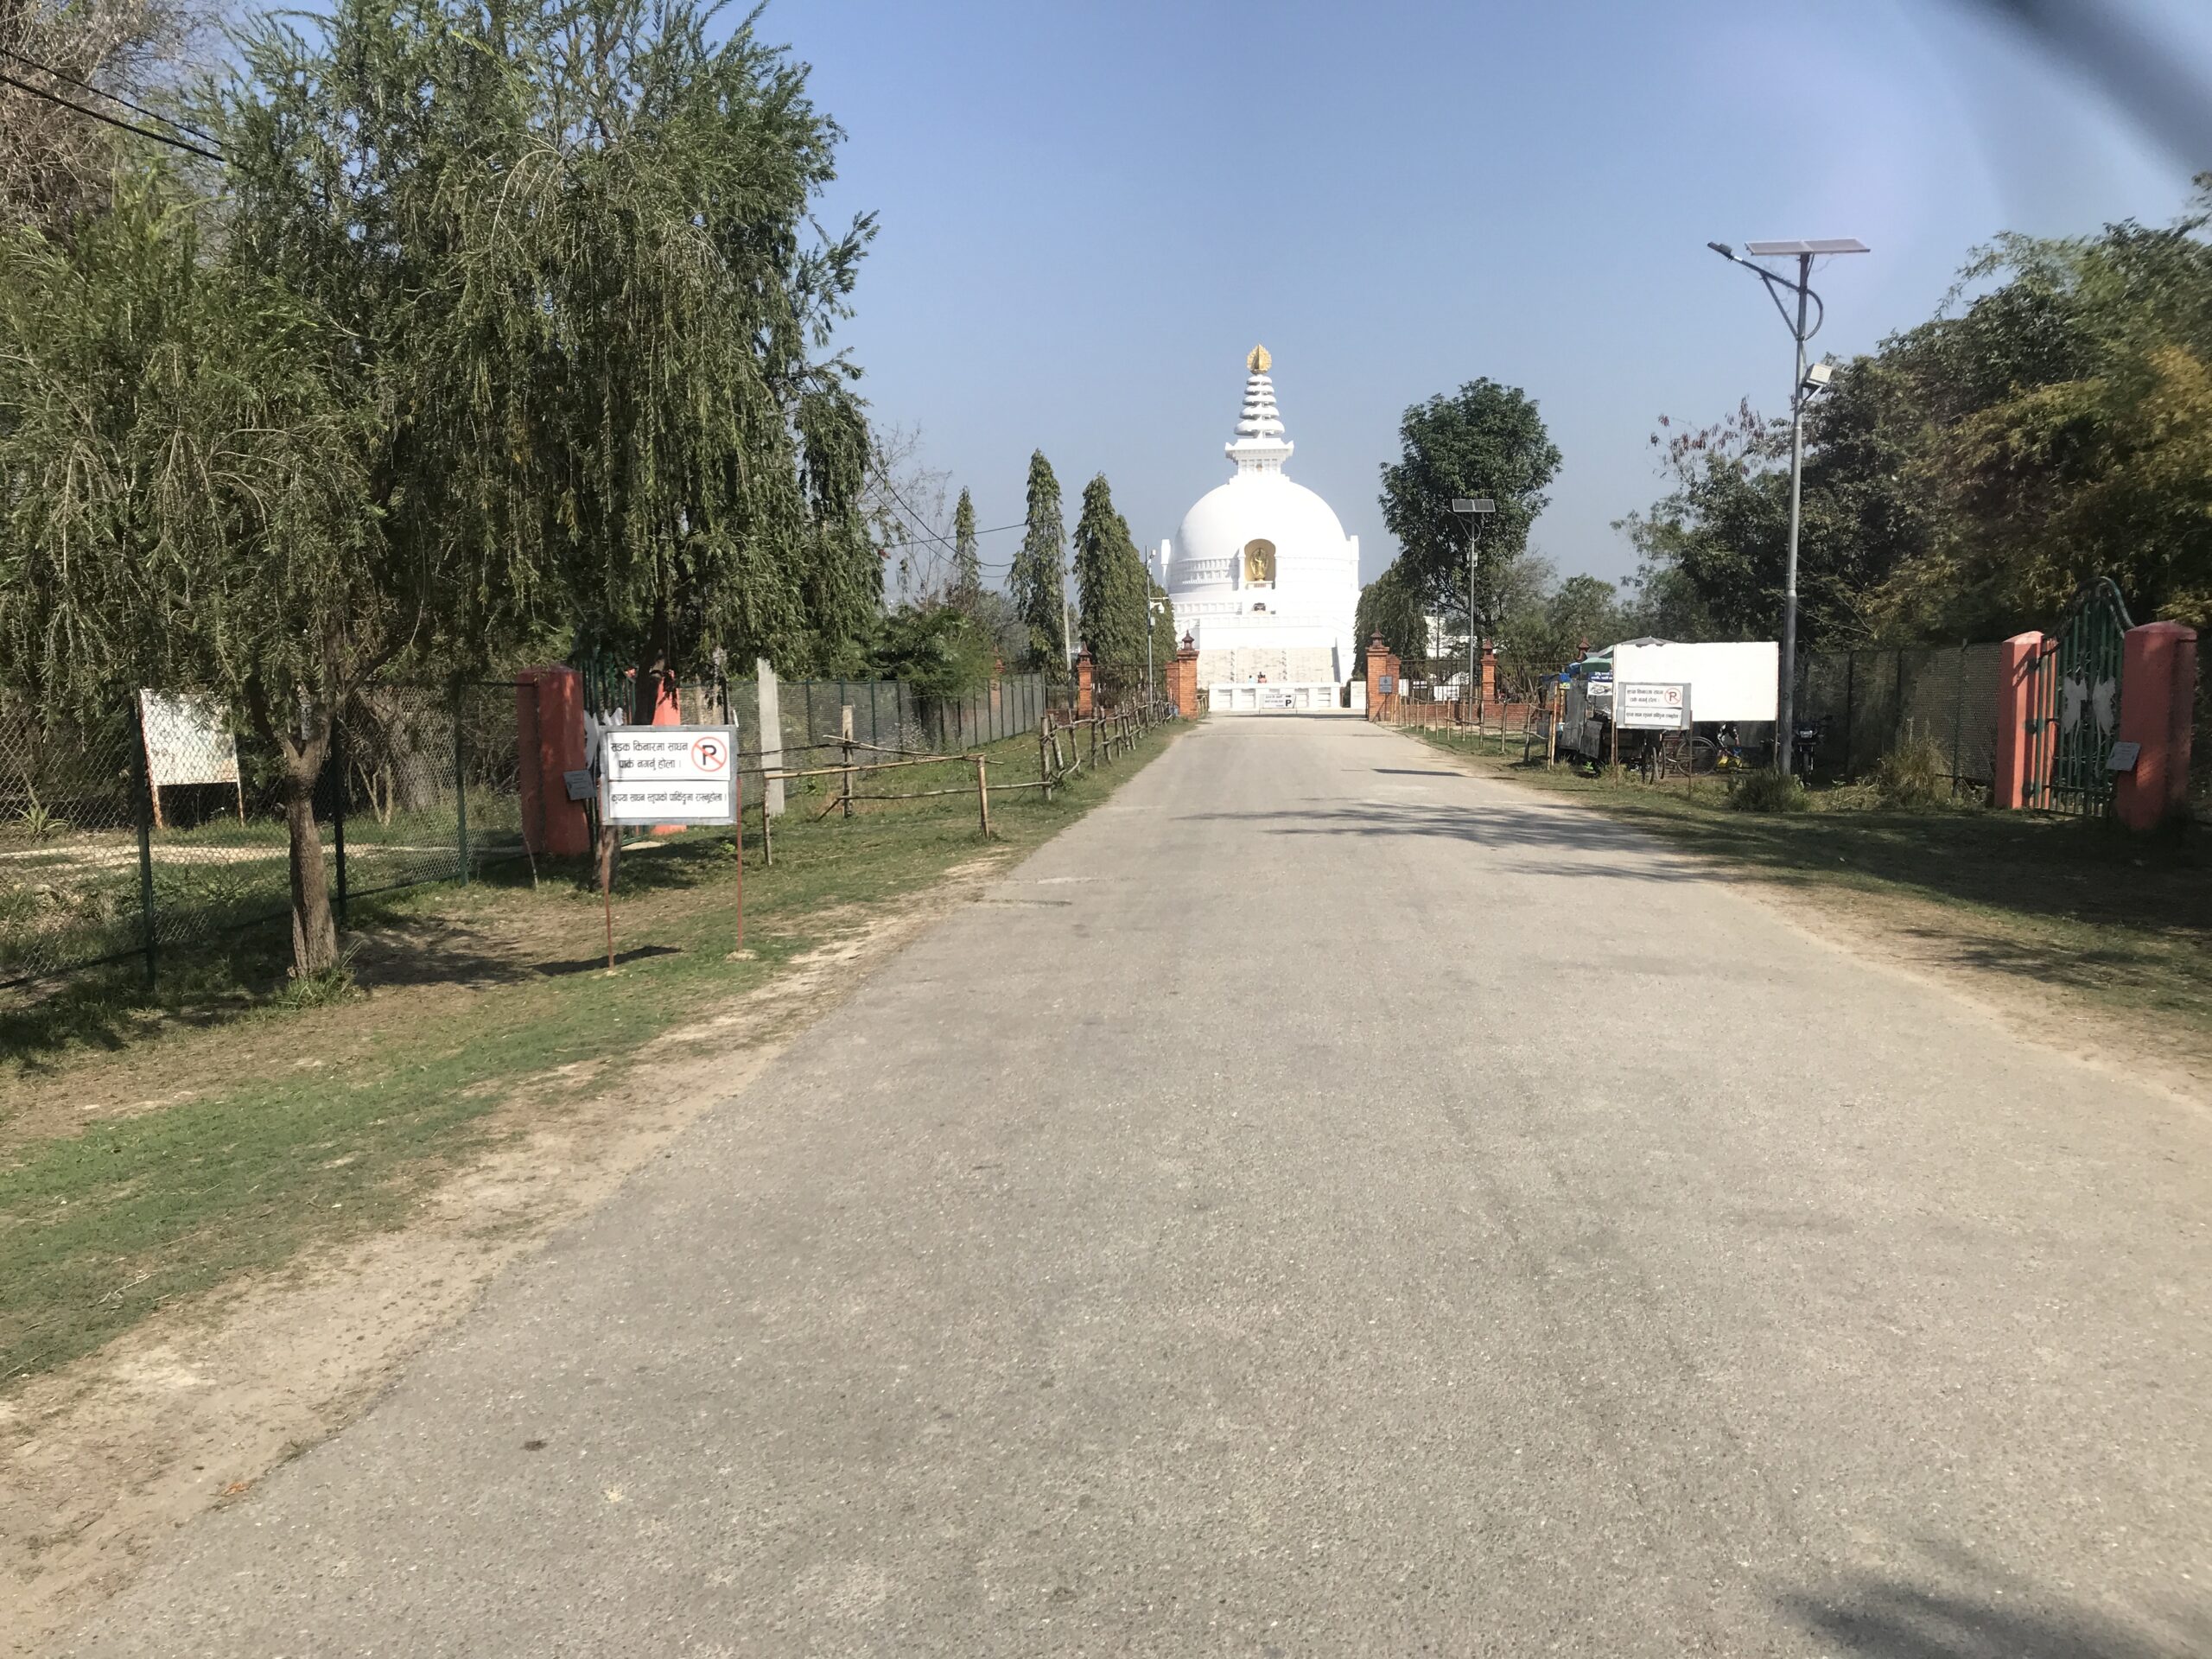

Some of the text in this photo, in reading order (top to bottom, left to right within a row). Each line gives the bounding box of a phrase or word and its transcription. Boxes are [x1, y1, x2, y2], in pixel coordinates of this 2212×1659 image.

[610, 742, 631, 752] सडक
[667, 742, 689, 752] साधन
[702, 744, 717, 766] P
[618, 758, 635, 768] पार्क
[658, 757, 676, 769] होला
